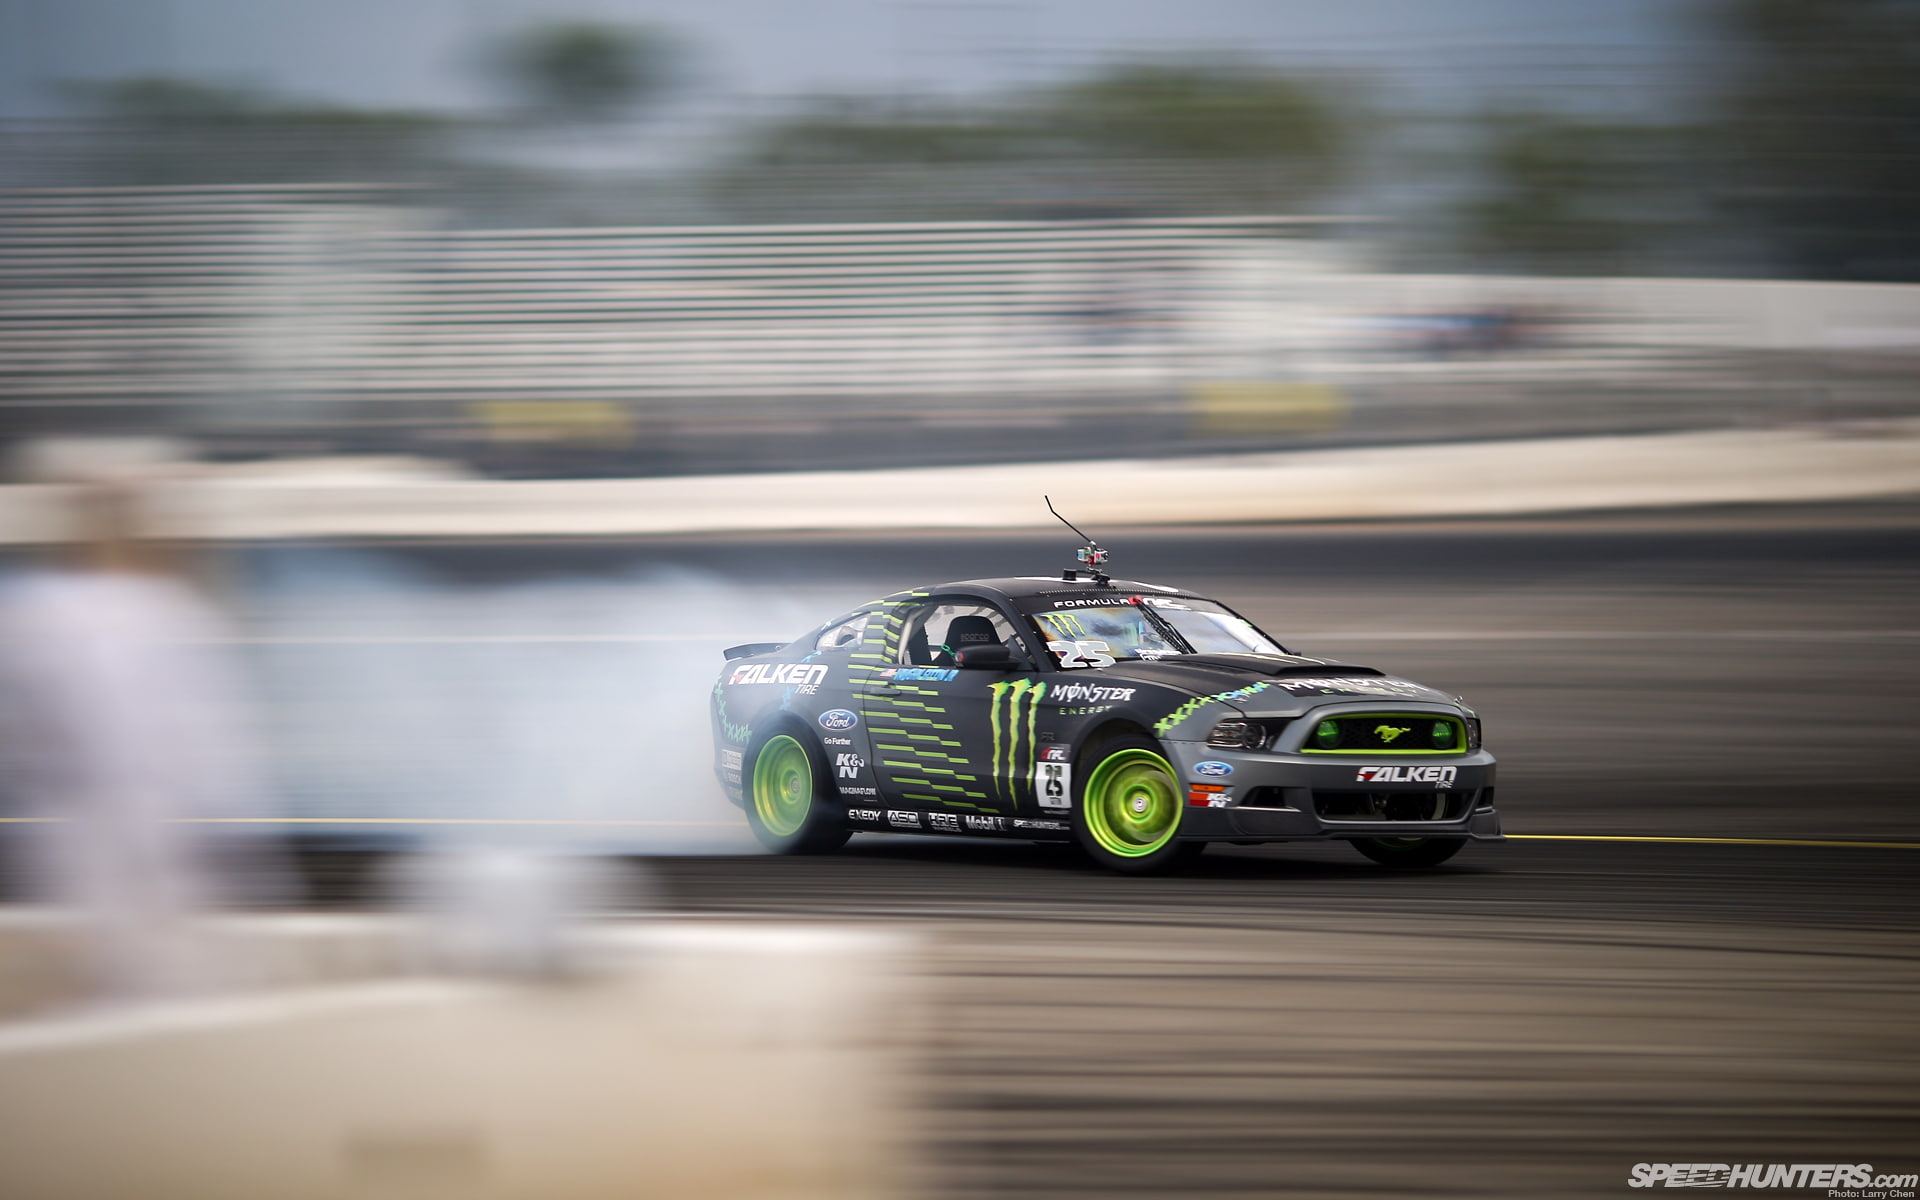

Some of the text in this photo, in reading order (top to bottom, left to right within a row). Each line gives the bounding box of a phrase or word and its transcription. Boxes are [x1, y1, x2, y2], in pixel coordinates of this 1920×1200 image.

[1053, 598, 1131, 609] FORMULA
[960, 633, 990, 641] sparco
[1046, 640, 1117, 668] 25
[728, 663, 829, 685] FALKEN
[794, 684, 819, 695] TIRE
[1050, 682, 1136, 702] MONSTER
[1059, 705, 1113, 715] ENERGY
[824, 737, 832, 745] Go
[1044, 764, 1064, 797] 25
[1355, 766, 1457, 782] FALKEN
[1435, 780, 1454, 789] TIRE
[848, 809, 881, 821] EXEDY
[965, 815, 996, 830] Mobil
